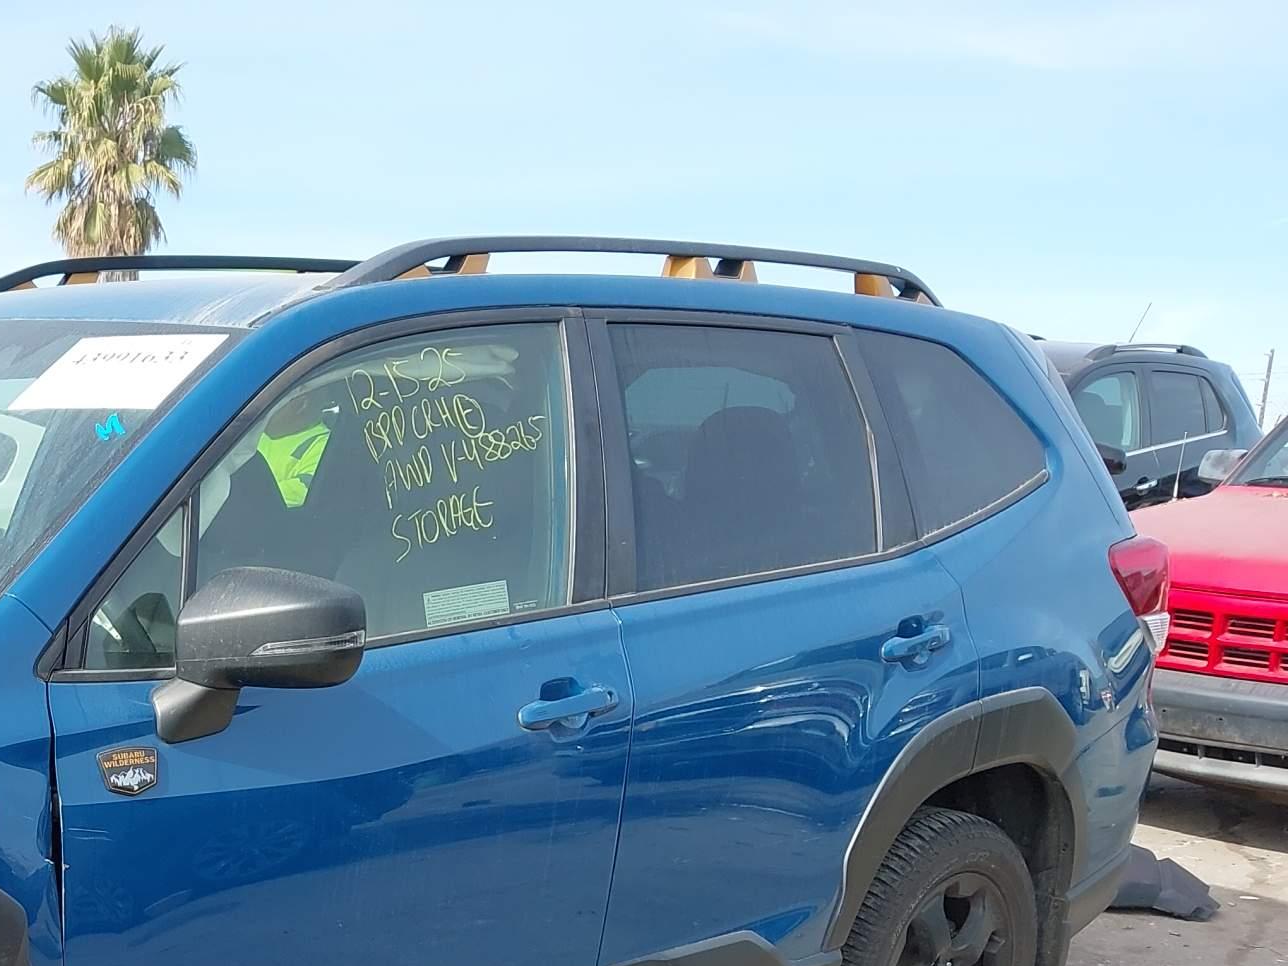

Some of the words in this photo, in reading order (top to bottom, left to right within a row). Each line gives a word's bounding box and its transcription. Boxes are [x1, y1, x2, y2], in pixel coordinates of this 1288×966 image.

[383, 445, 433, 510] AWD
[391, 486, 495, 563] STORAGE
[103, 756, 155, 769] WILDERNESS
[112, 750, 145, 761] SUBARU
